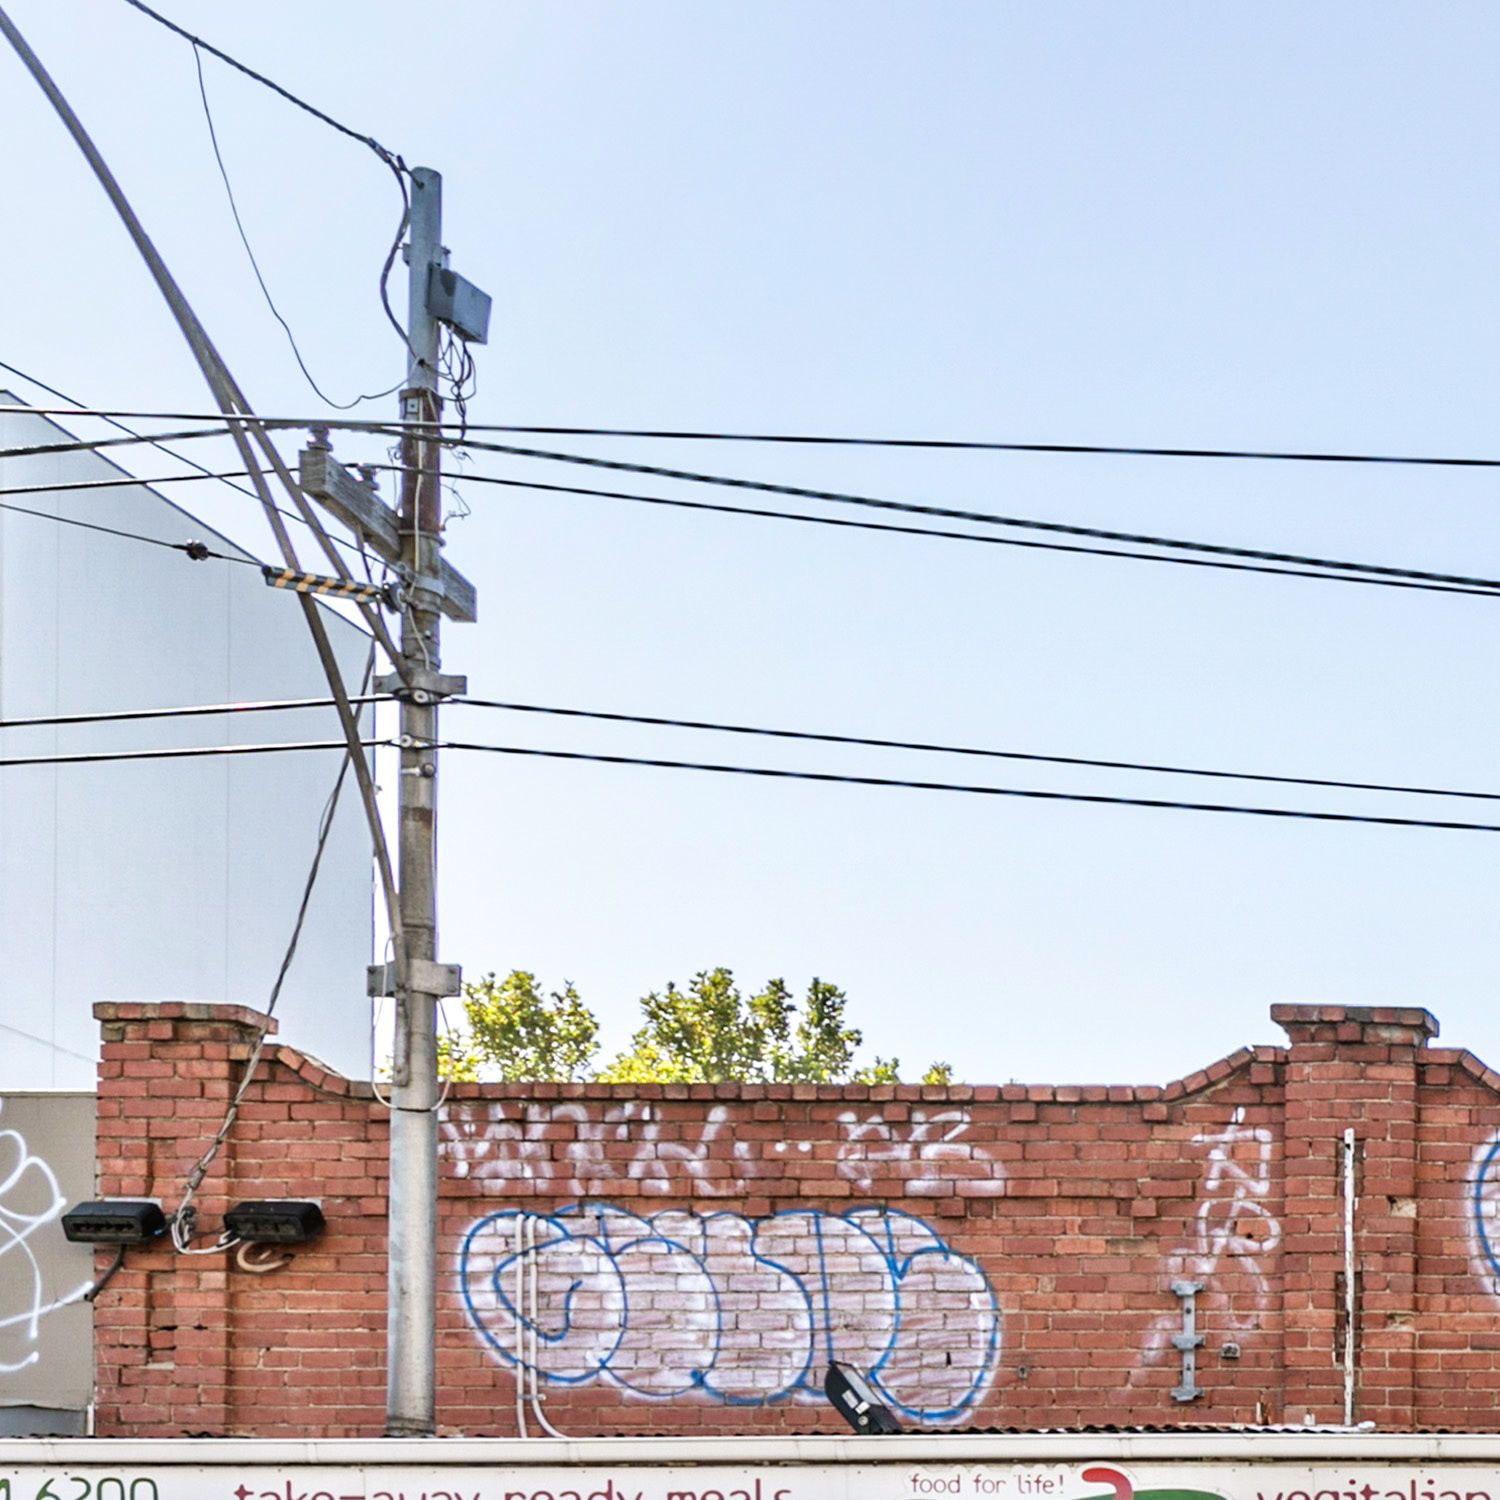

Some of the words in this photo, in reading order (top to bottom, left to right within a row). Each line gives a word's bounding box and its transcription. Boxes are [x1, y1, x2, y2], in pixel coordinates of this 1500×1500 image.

[910, 1474, 961, 1495] food
[973, 1474, 1007, 1495] for
[1017, 1473, 1064, 1495] life!
